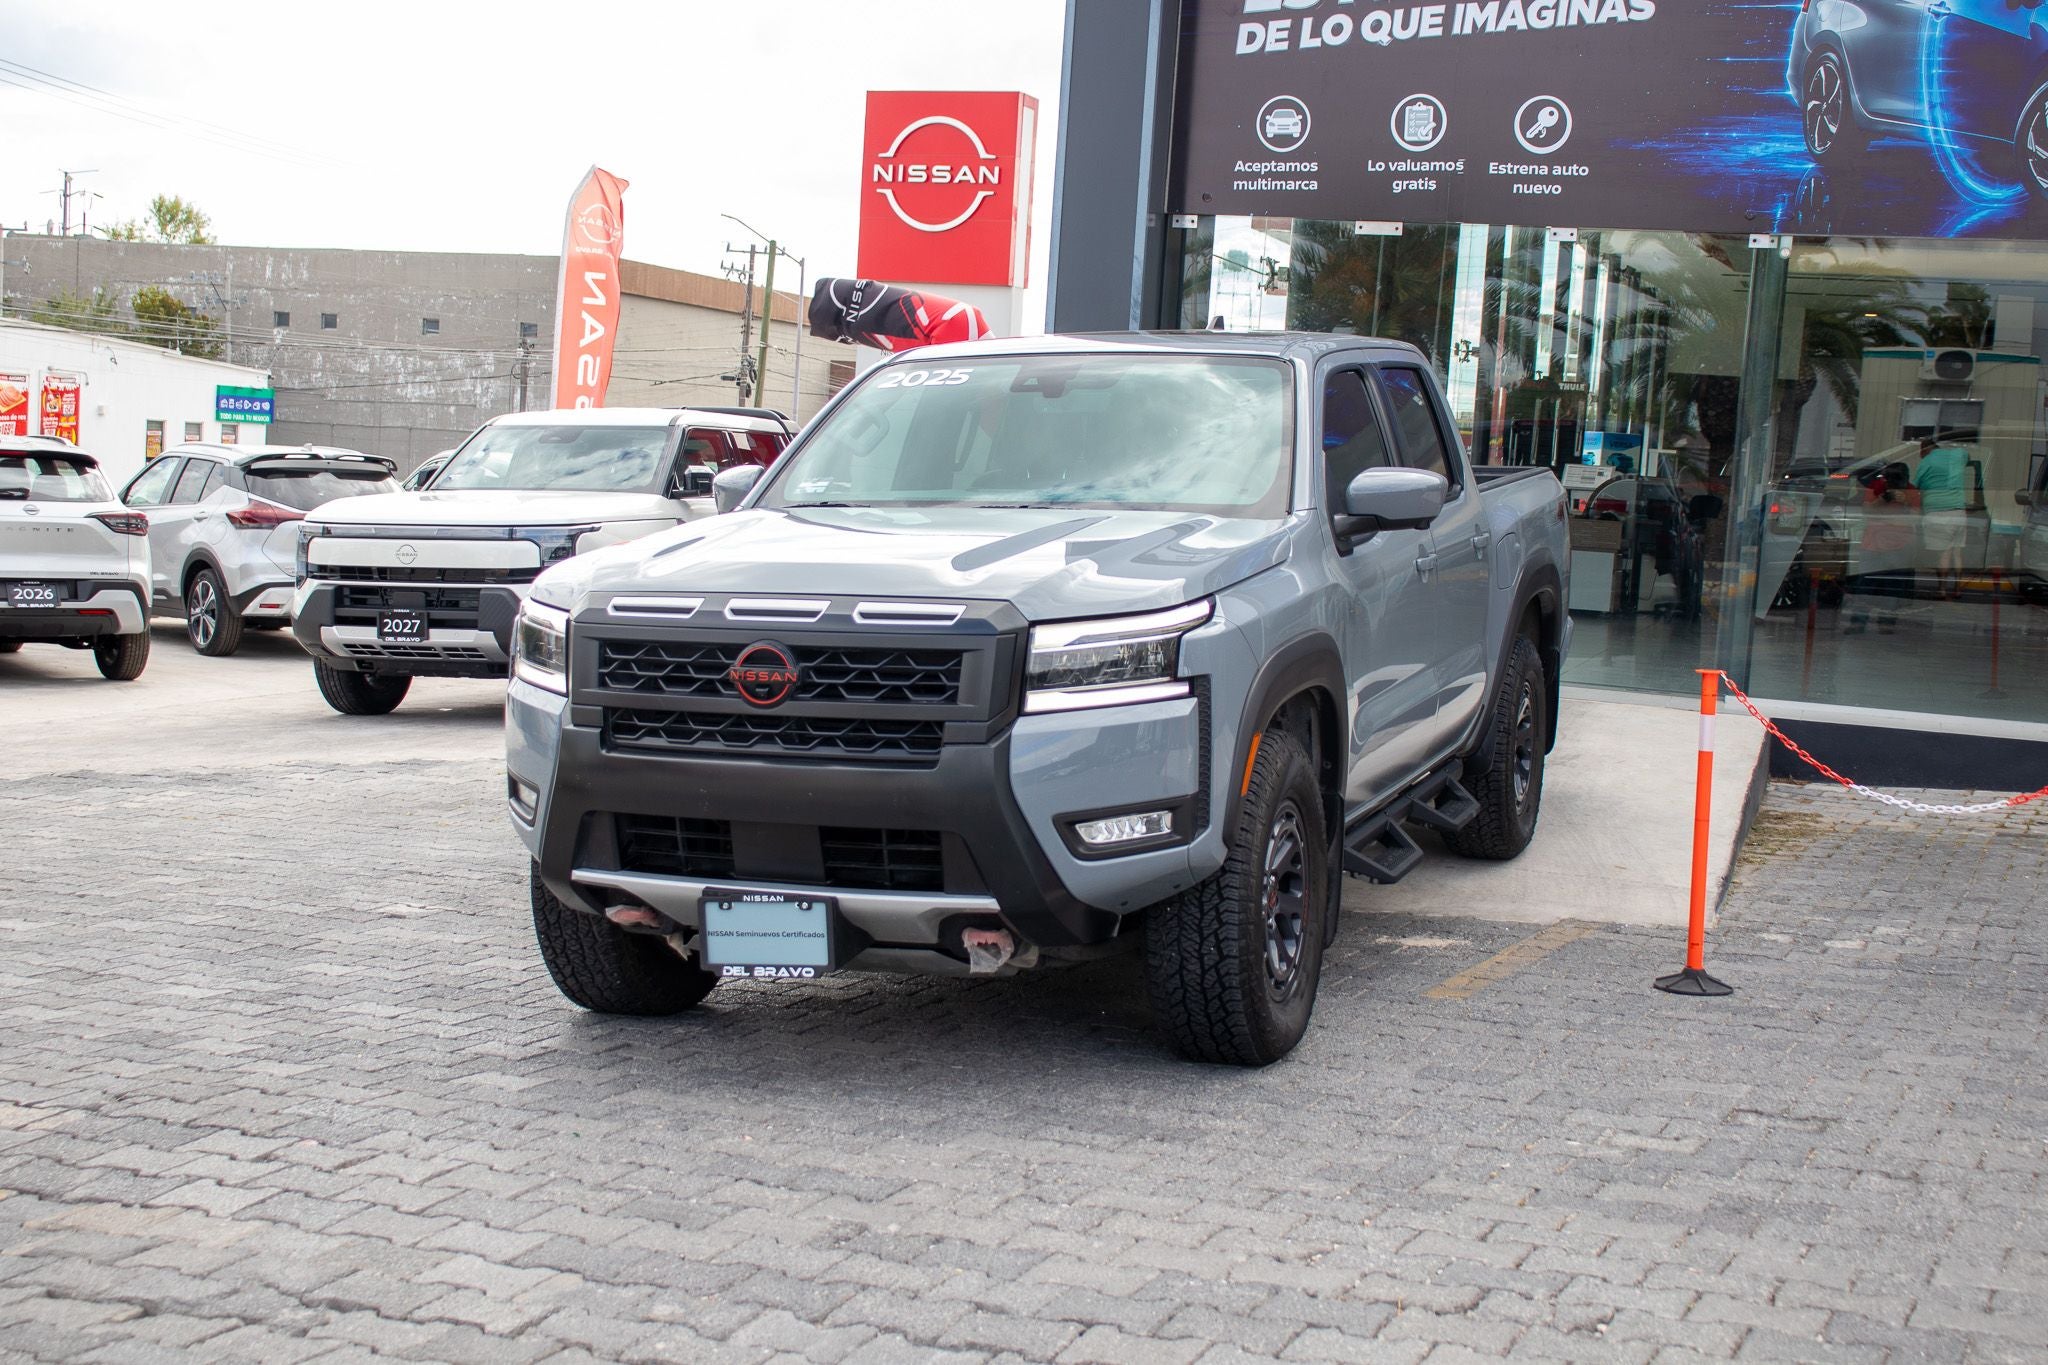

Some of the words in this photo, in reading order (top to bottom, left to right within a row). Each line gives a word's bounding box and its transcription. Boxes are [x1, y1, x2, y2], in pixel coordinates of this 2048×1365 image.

[1235, 19, 1292, 55] DE
[1299, 13, 1353, 49] LO
[1360, 4, 1446, 46] QUE
[1451, 0, 1656, 36] IMAGINAS
[1234, 160, 1318, 174] Aceptamos
[1367, 160, 1385, 172] Lo
[1388, 159, 1465, 172] valuamos
[1489, 162, 1548, 176] Estrena
[1552, 163, 1590, 176] auto
[872, 163, 1000, 185] NISSAN
[1233, 178, 1318, 190] multimarca
[1392, 177, 1437, 193] gratis
[1512, 183, 1562, 195] nuevo
[877, 368, 974, 389] 2025
[1559, 383, 1585, 391] THULE
[13, 588, 54, 600] 2026
[383, 619, 420, 633] 2027
[729, 670, 797, 682] NISSAN
[781, 931, 825, 939] Certificados
[722, 966, 750, 977] DEL
[753, 967, 815, 977] BRAVO
